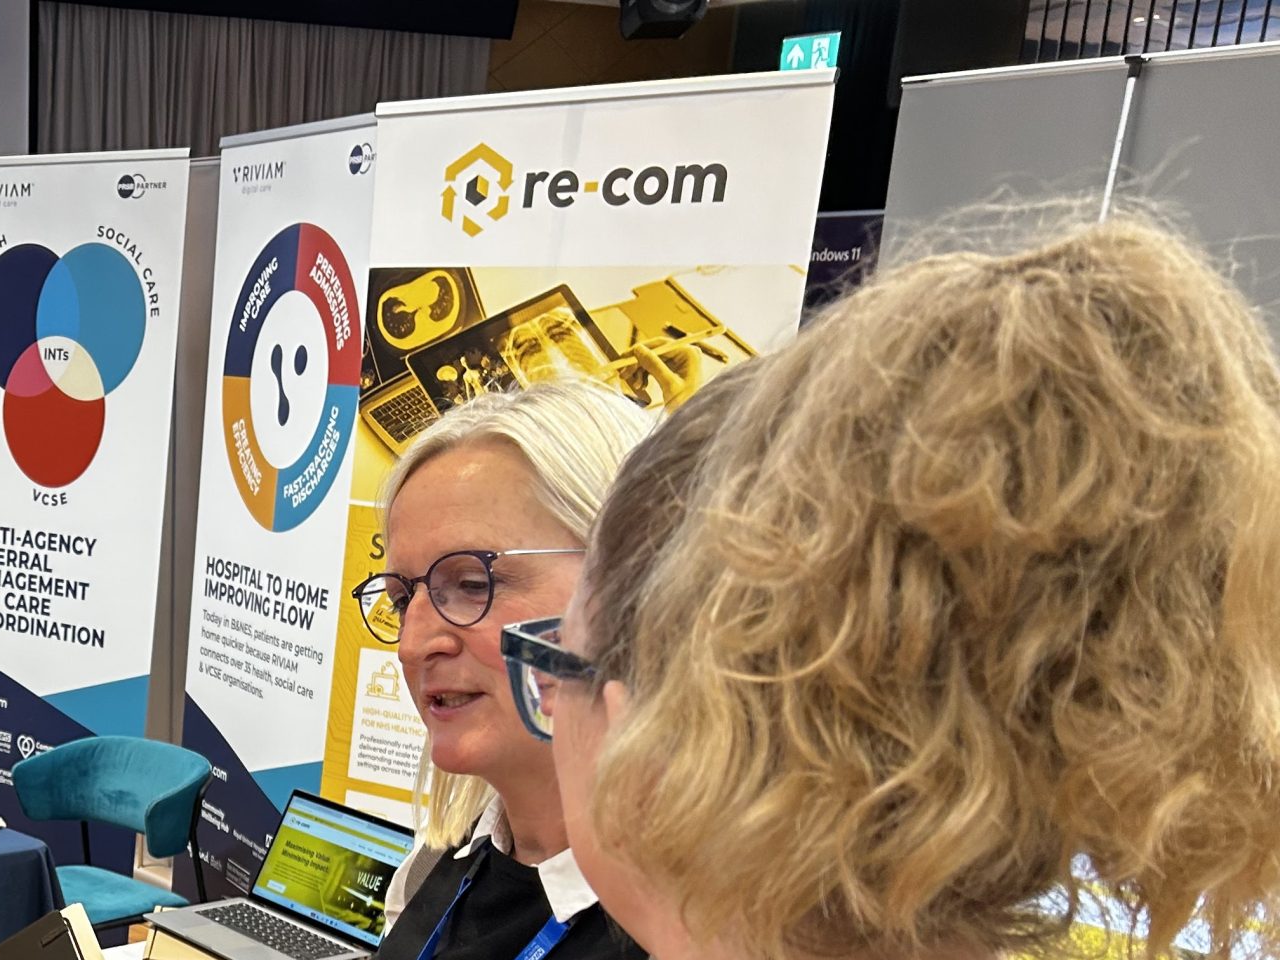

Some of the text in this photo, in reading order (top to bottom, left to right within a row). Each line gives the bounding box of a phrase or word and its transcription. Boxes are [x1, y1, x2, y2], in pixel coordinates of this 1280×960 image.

[243, 161, 284, 182] RIVIAM
[522, 162, 728, 209] re-com
[97, 225, 141, 266] SOCIAL
[143, 268, 160, 317] CARE
[812, 247, 849, 261] ndows
[239, 257, 278, 332] IMPROVING
[251, 282, 271, 319] CARE
[309, 266, 345, 350] ADMISSIONS
[316, 253, 352, 340] PREVENTING
[44, 348, 69, 361] INTs
[232, 421, 260, 496] EFFICIENCY
[238, 419, 262, 484] CREATING
[283, 406, 339, 498] FAST-TRACKING
[292, 431, 340, 508] DISCHARGES
[33, 488, 67, 507] VCSE
[4, 592, 51, 617] CARE
[204, 578, 314, 630] IMPROVING FLOW
[206, 555, 329, 610] HOSPITAL TO HOME
[201, 627, 298, 674] home quicker because RIVIAM
[203, 609, 222, 627] Today
[223, 614, 230, 628] in
[253, 629, 280, 647] patients
[281, 640, 293, 652] are
[294, 644, 324, 665] getting
[200, 646, 229, 665] connects
[230, 658, 244, 670] over
[274, 676, 295, 692] social
[297, 685, 314, 699] care
[205, 664, 222, 680] VCSE
[222, 673, 264, 699] organisations.
[357, 871, 382, 892] VALUE
